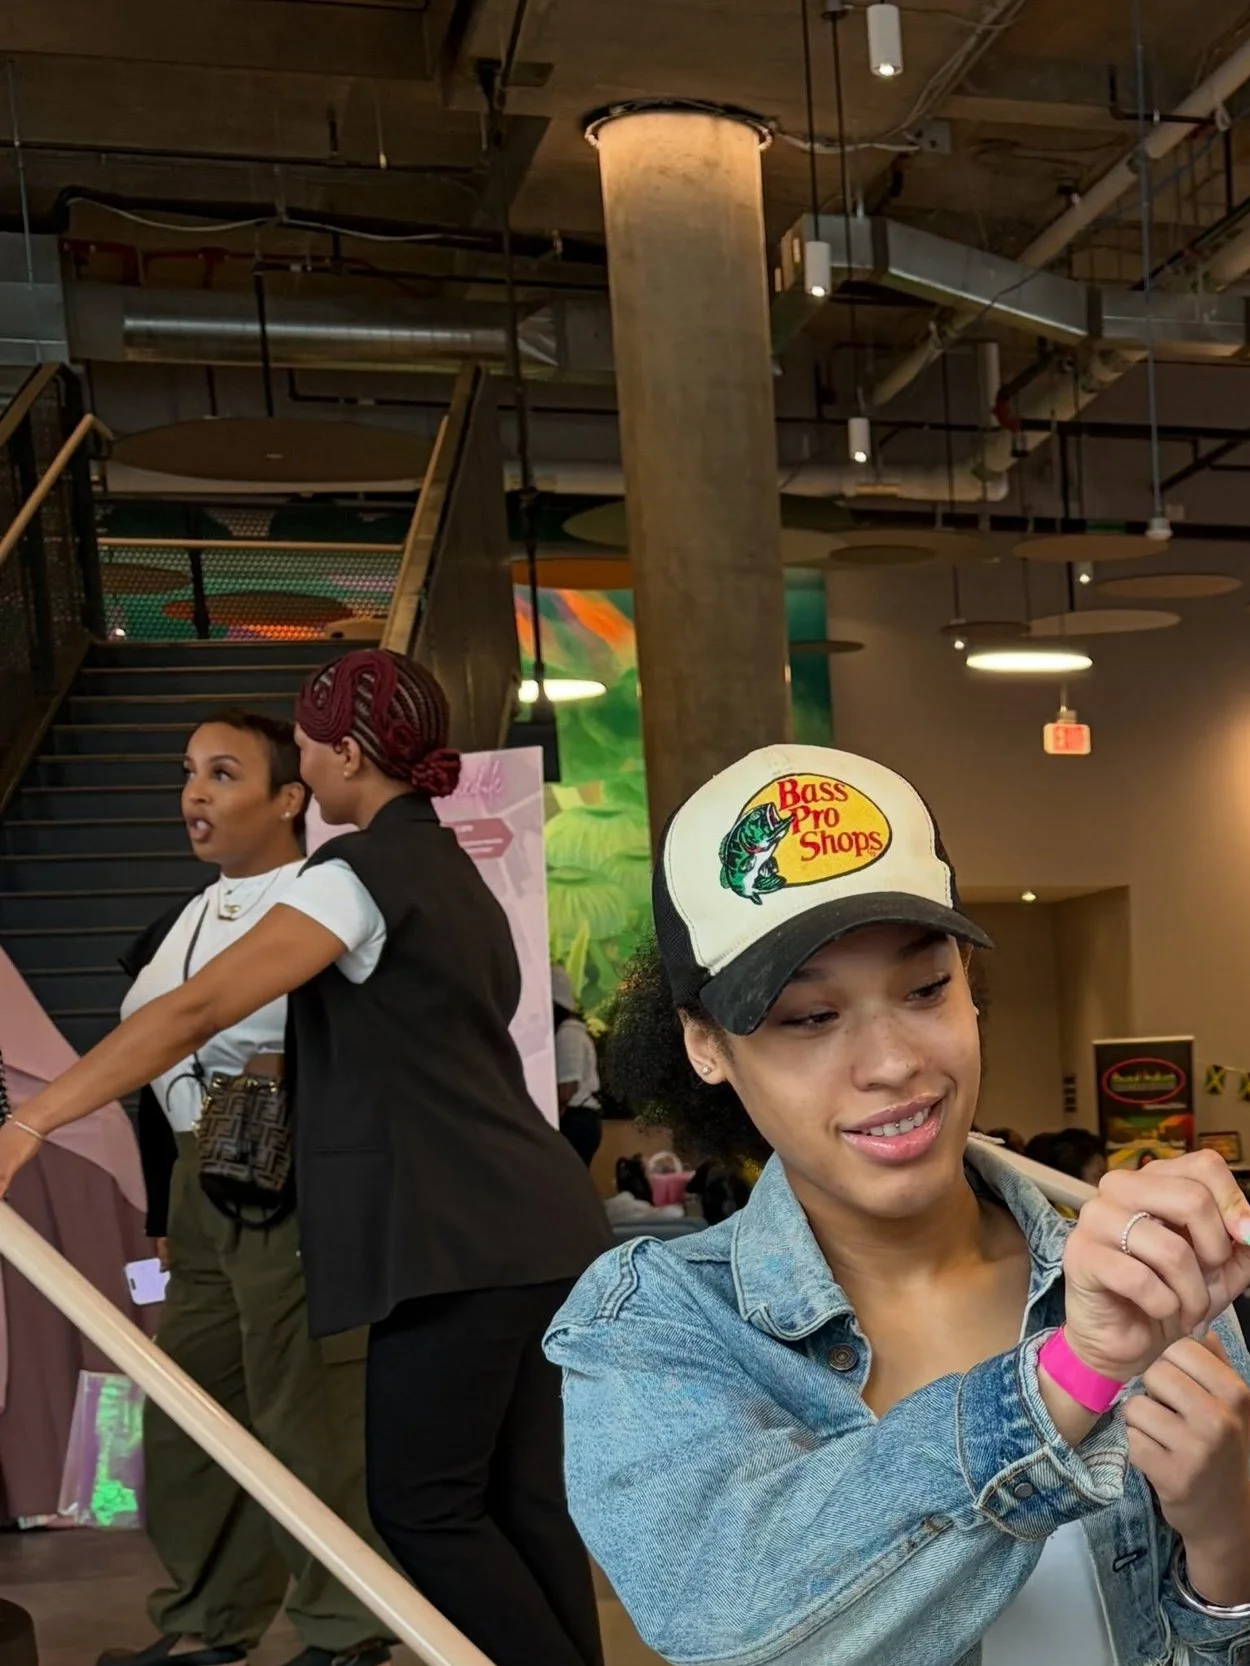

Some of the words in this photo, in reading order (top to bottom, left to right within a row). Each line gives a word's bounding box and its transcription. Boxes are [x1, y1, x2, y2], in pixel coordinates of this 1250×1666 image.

[777, 779, 848, 811] Bass
[789, 805, 840, 834] Pro
[800, 830, 883, 862] Shops
